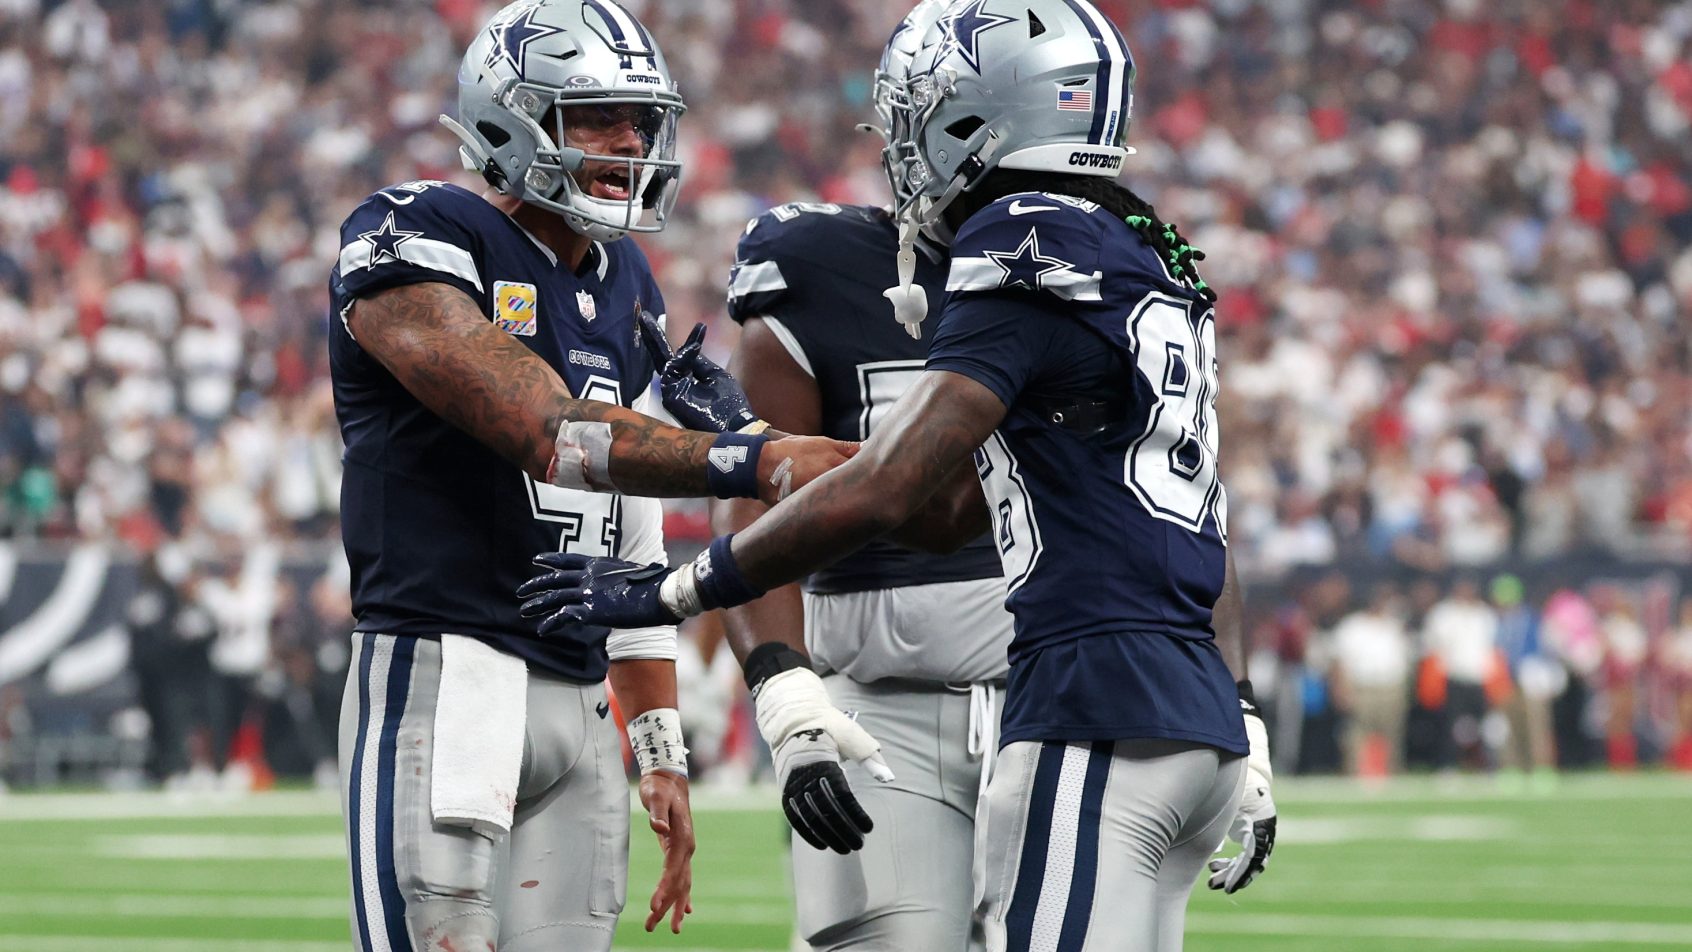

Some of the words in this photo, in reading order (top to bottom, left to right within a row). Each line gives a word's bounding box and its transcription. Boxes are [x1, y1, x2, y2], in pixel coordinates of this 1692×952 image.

[626, 74, 661, 84] COWBOYS
[568, 349, 611, 370] COWBOYS
[707, 445, 749, 474] 4
